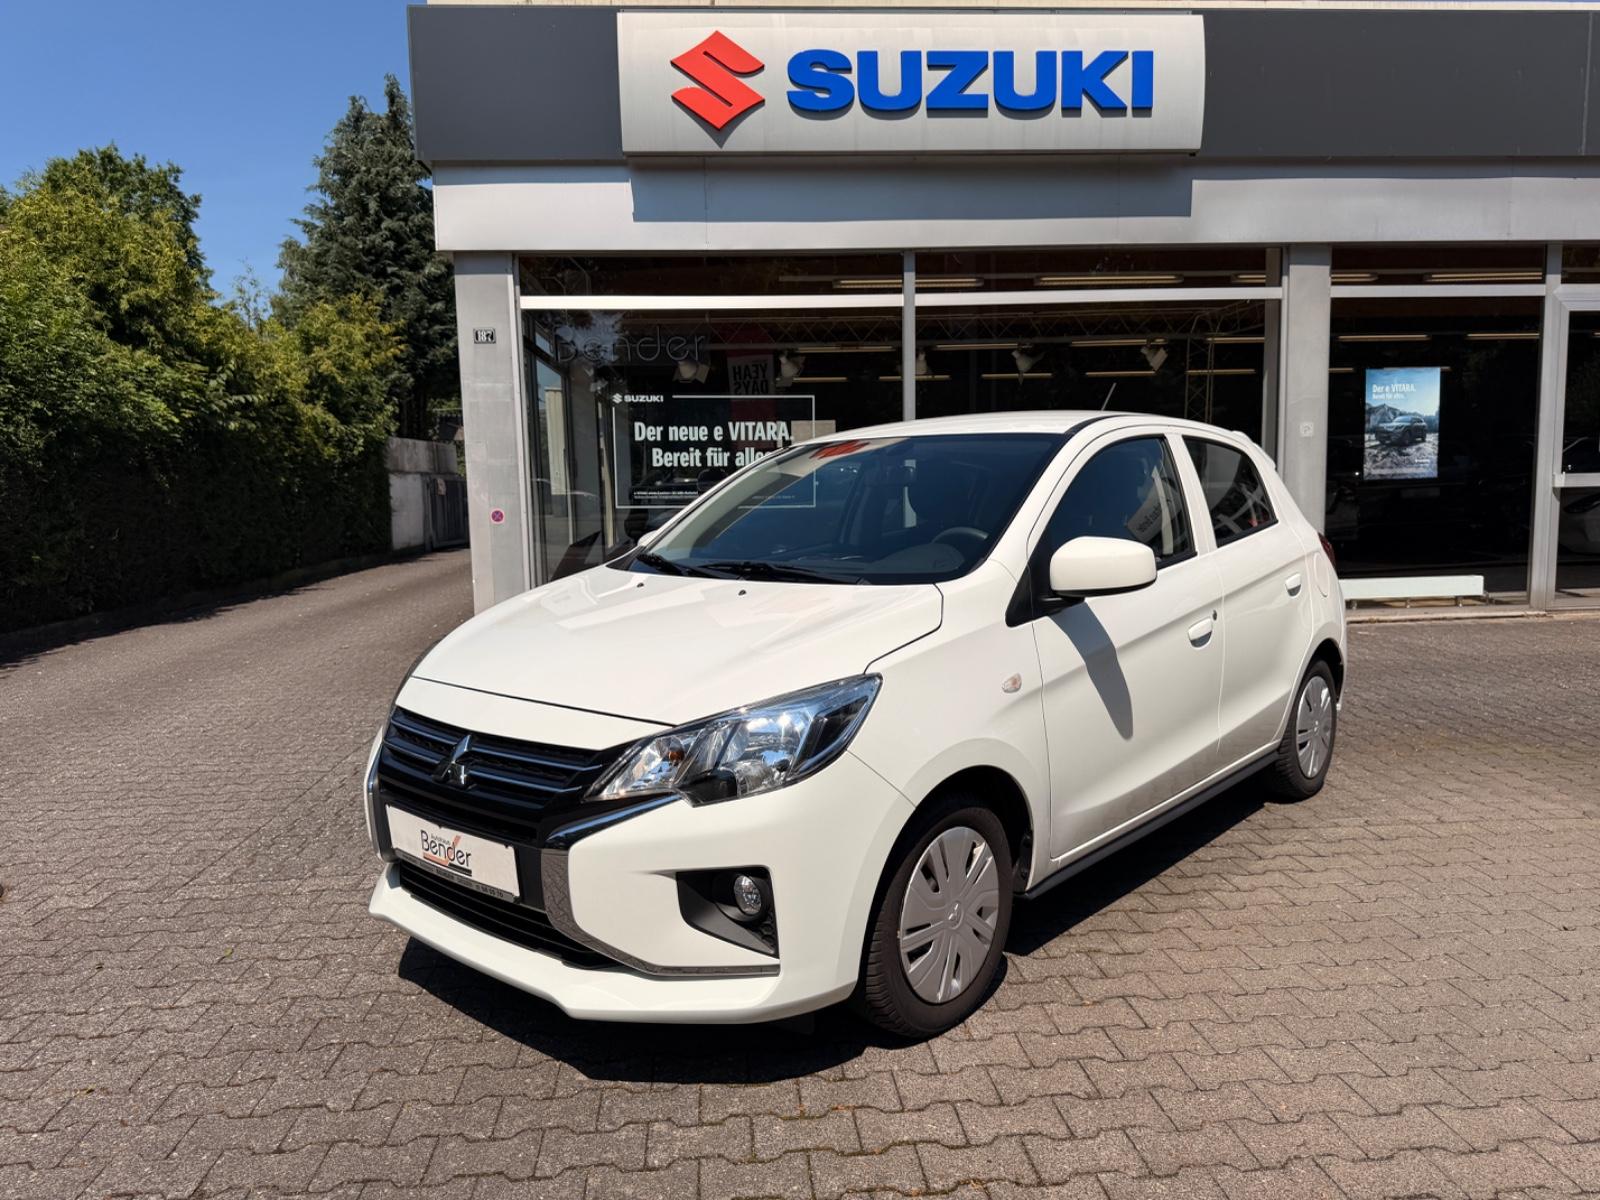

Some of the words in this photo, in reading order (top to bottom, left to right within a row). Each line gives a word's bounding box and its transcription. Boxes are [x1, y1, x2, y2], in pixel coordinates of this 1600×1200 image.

[786, 49, 1153, 115] SUZUKI
[624, 394, 664, 403] SUZUKI
[633, 421, 663, 441] Der
[668, 424, 709, 441] neue
[713, 424, 723, 441] e
[728, 421, 795, 441] VITARA.
[652, 447, 702, 467] Bereit
[706, 447, 730, 467] für
[420, 829, 472, 867] Bender
